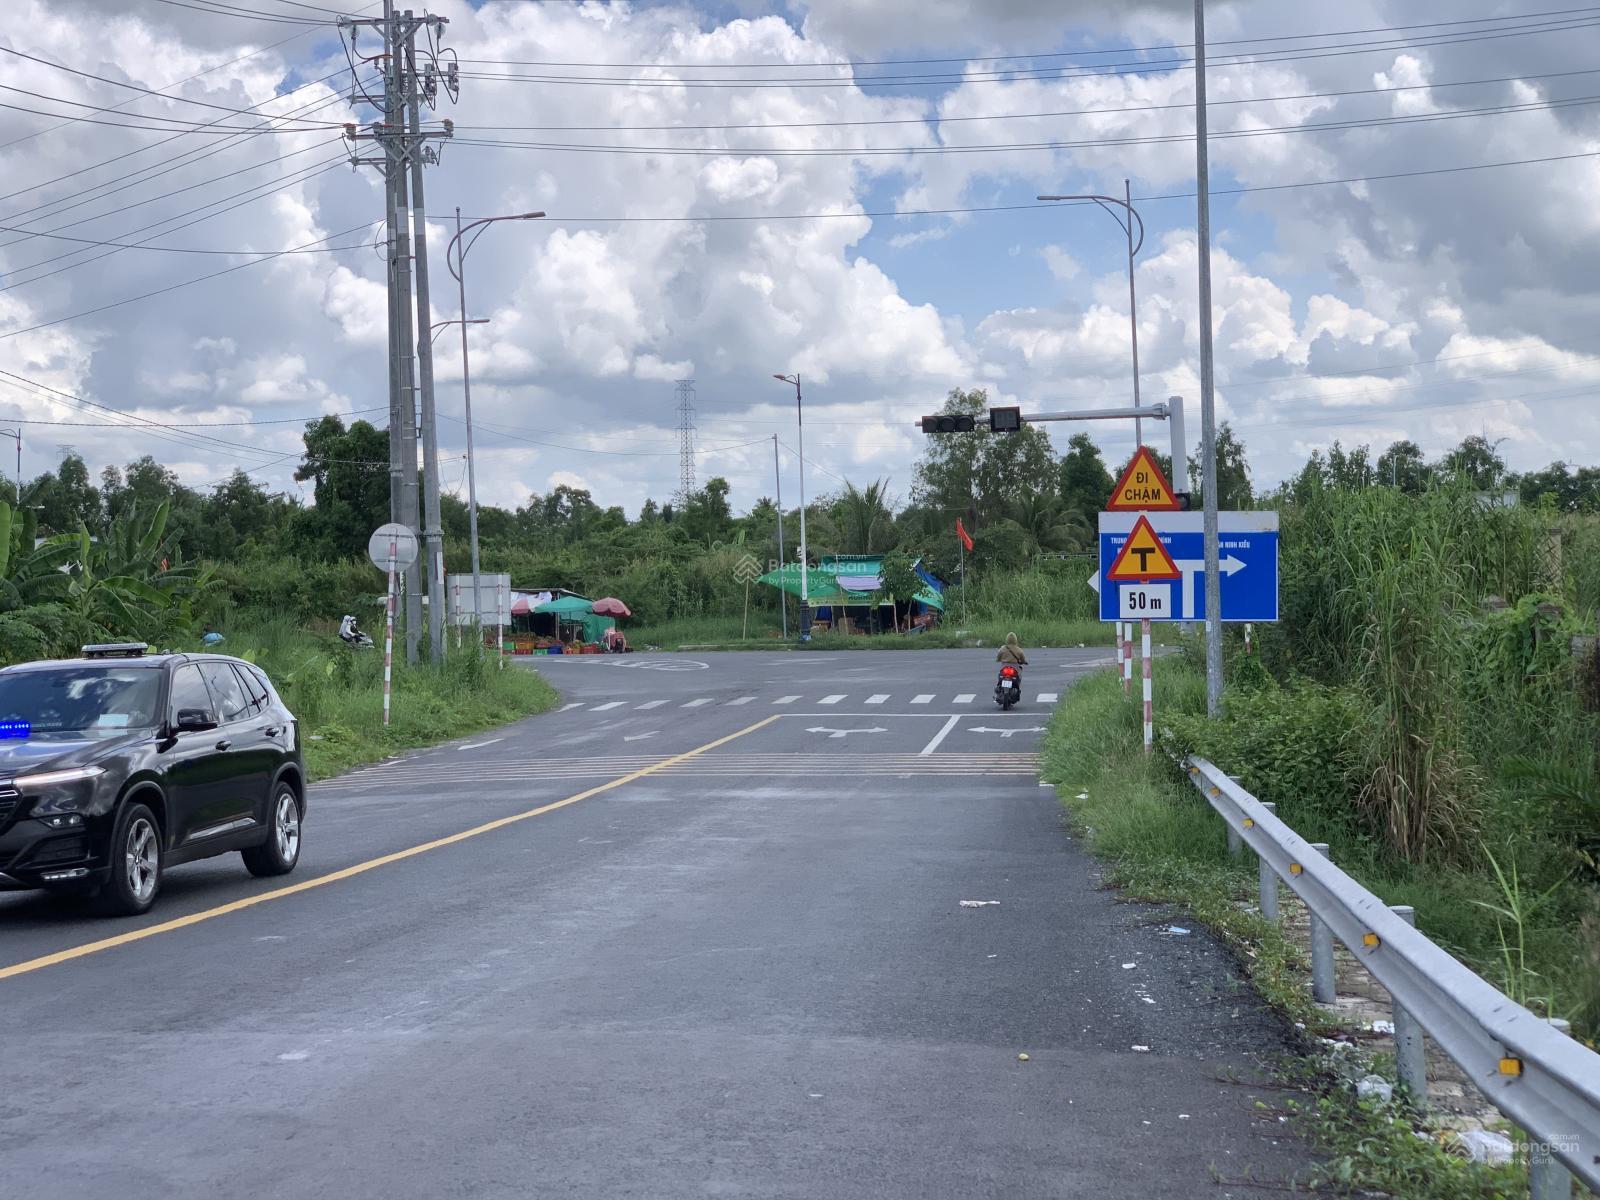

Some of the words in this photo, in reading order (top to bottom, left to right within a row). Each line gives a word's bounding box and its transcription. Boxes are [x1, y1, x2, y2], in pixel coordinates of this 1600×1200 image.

[1136, 471, 1148, 484] ĐI
[1124, 486, 1161, 503] CHẬM
[1129, 591, 1146, 610] 50
[1150, 598, 1162, 610] m
